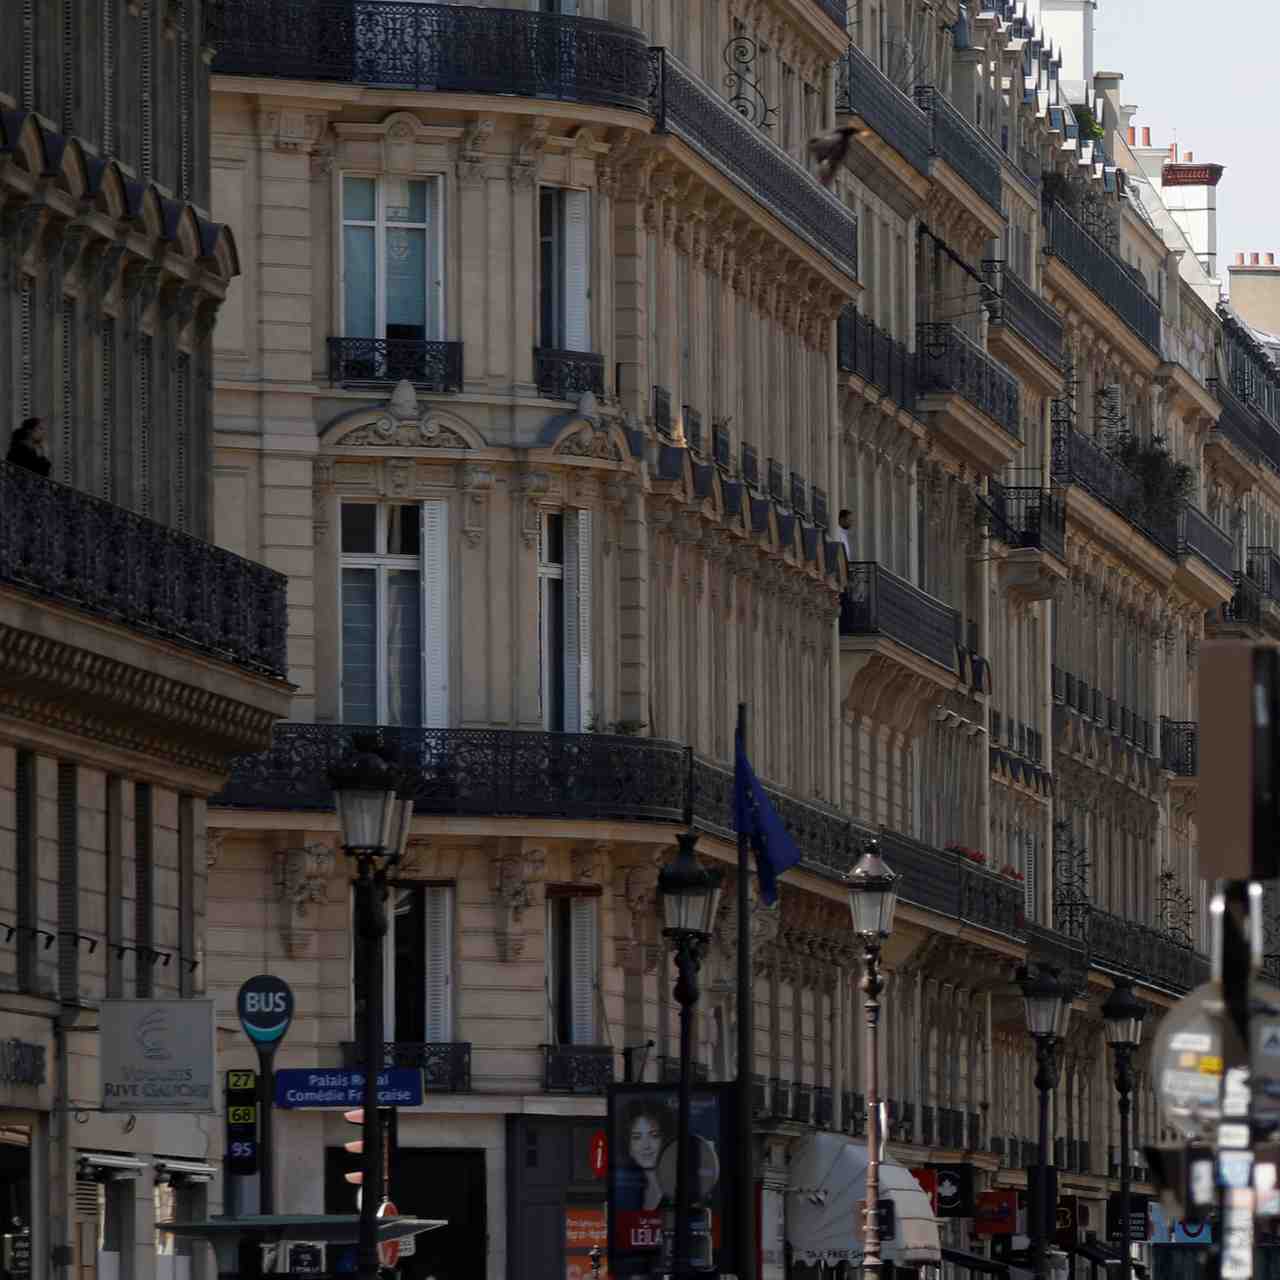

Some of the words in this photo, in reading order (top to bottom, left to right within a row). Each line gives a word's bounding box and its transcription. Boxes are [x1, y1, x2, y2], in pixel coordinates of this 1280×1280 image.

[245, 992, 287, 1013] BUS
[232, 1073, 250, 1088] 27
[308, 1074, 348, 1087] Palais
[351, 1074, 389, 1087] Ral
[286, 1089, 344, 1102] Comédie
[347, 1089, 412, 1102] Frçaise
[231, 1108, 250, 1122] 68
[232, 1143, 250, 1157] 95
